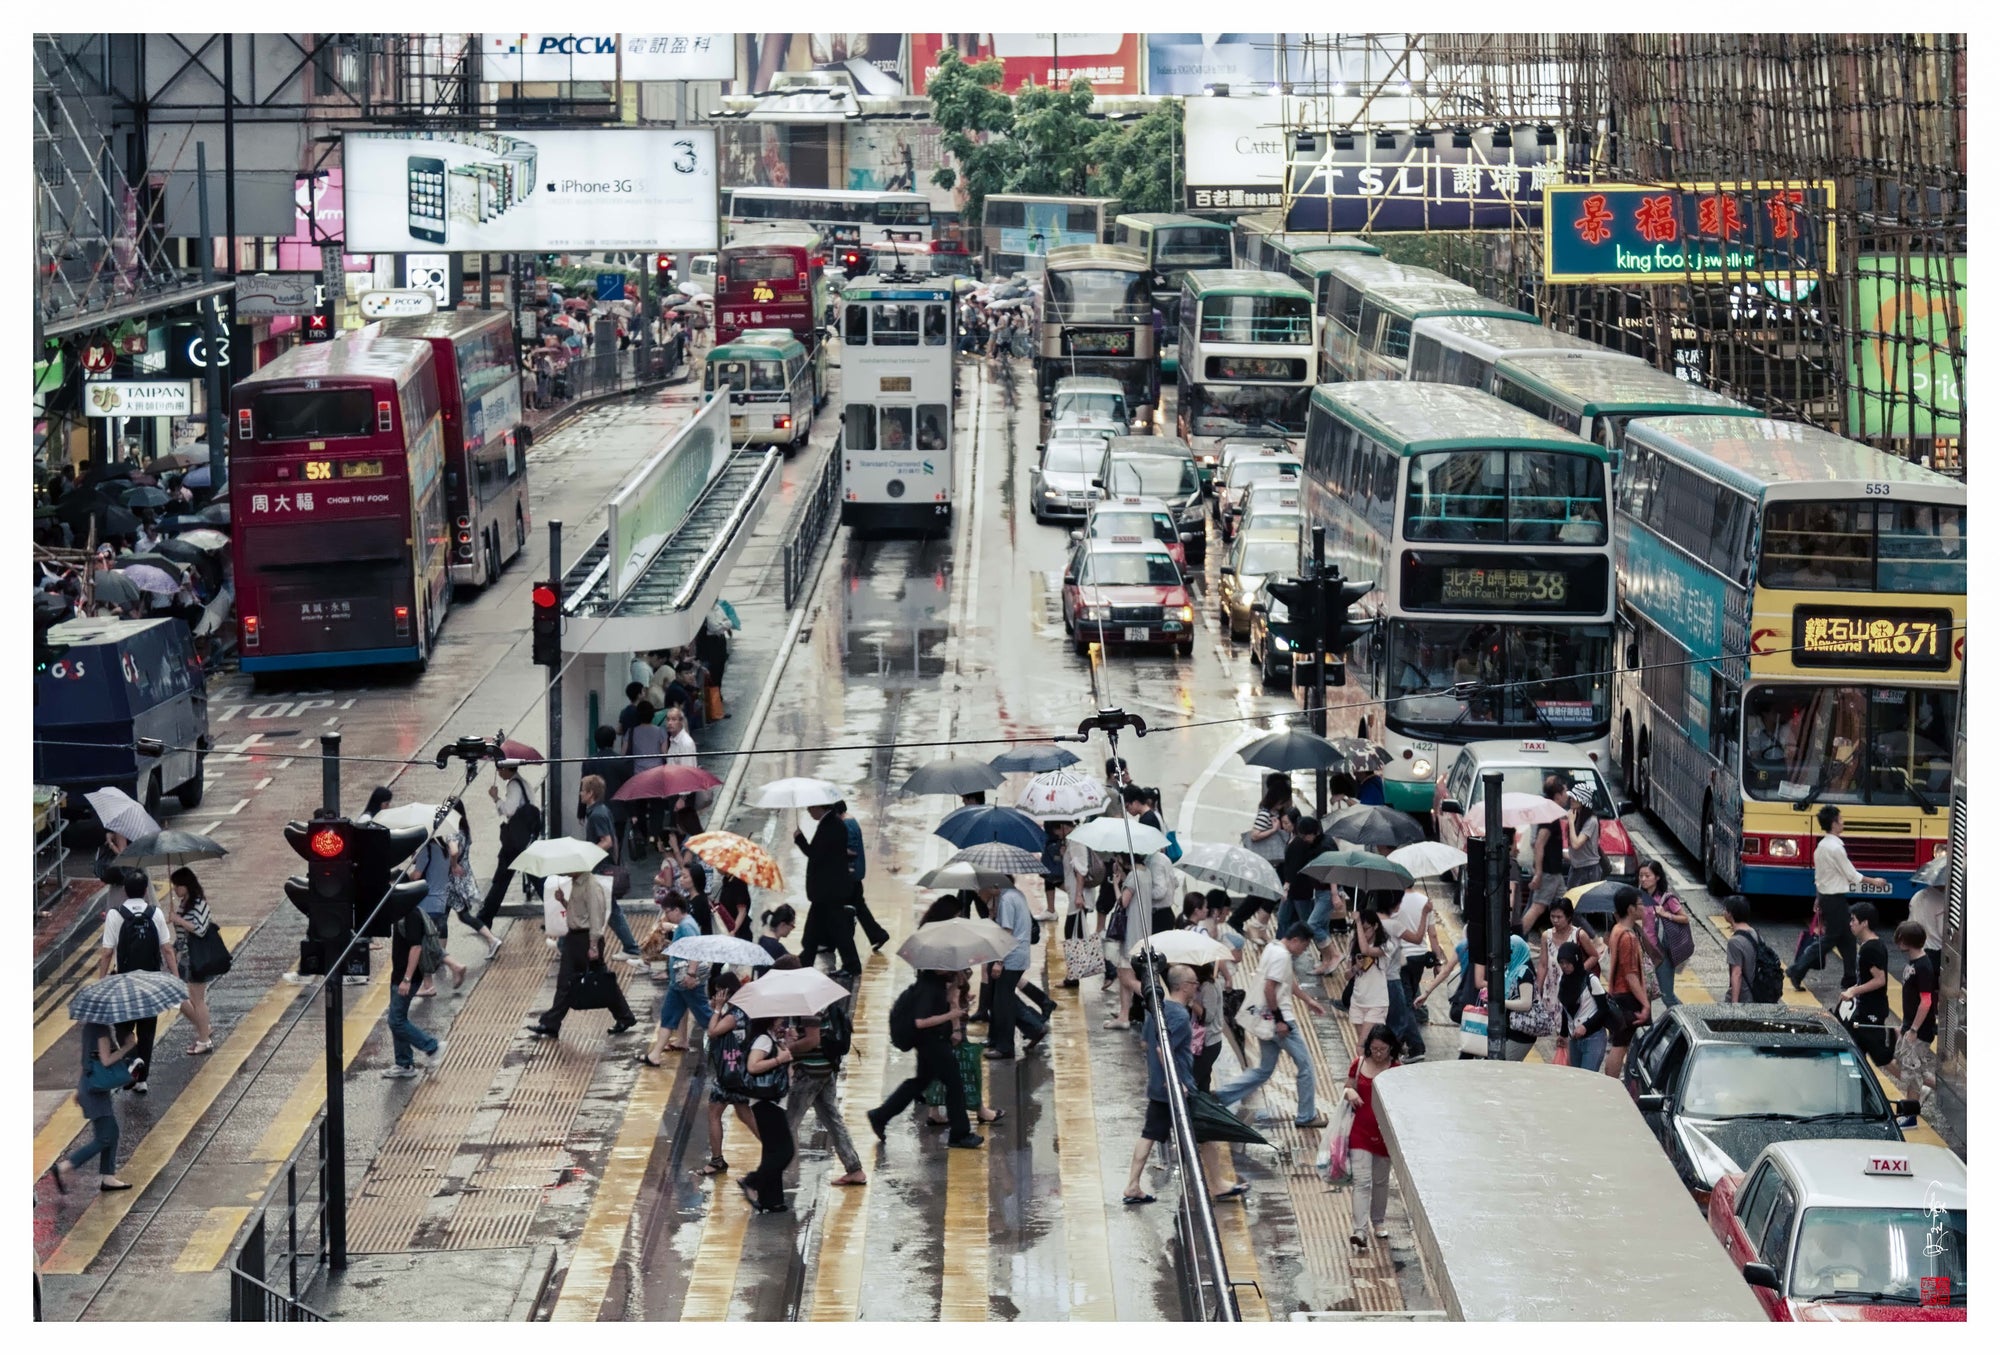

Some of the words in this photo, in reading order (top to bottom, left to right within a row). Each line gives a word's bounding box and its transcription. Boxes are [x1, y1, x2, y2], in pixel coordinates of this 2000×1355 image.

[538, 36, 617, 54] PCCW
[628, 36, 711, 54] 電訊盈科
[561, 179, 610, 193] iPhone
[1315, 167, 1425, 195] TSL
[1616, 244, 1651, 272] king
[753, 288, 774, 300] 72A
[933, 292, 944, 300] 24
[723, 311, 763, 324] 周大福
[308, 329, 327, 338] DBS
[1105, 334, 1127, 348] 968
[127, 387, 185, 398] TAIPAN
[305, 462, 331, 479] 5X
[1866, 484, 1890, 495] 553
[252, 493, 314, 513] 周大福
[935, 506, 948, 514] 24
[1445, 569, 1529, 587] 北角碼頭
[1443, 586, 1472, 599] North
[1474, 587, 1500, 599] Point
[1503, 587, 1532, 600] Ferry
[1531, 573, 1564, 600] 38
[1805, 635, 1862, 653] Diamond
[1868, 639, 1894, 654] Hill
[1893, 622, 1937, 655] 671
[1412, 742, 1433, 751] 1422
[1523, 742, 1546, 750] TAXI
[1872, 1159, 1908, 1171] TAXI
